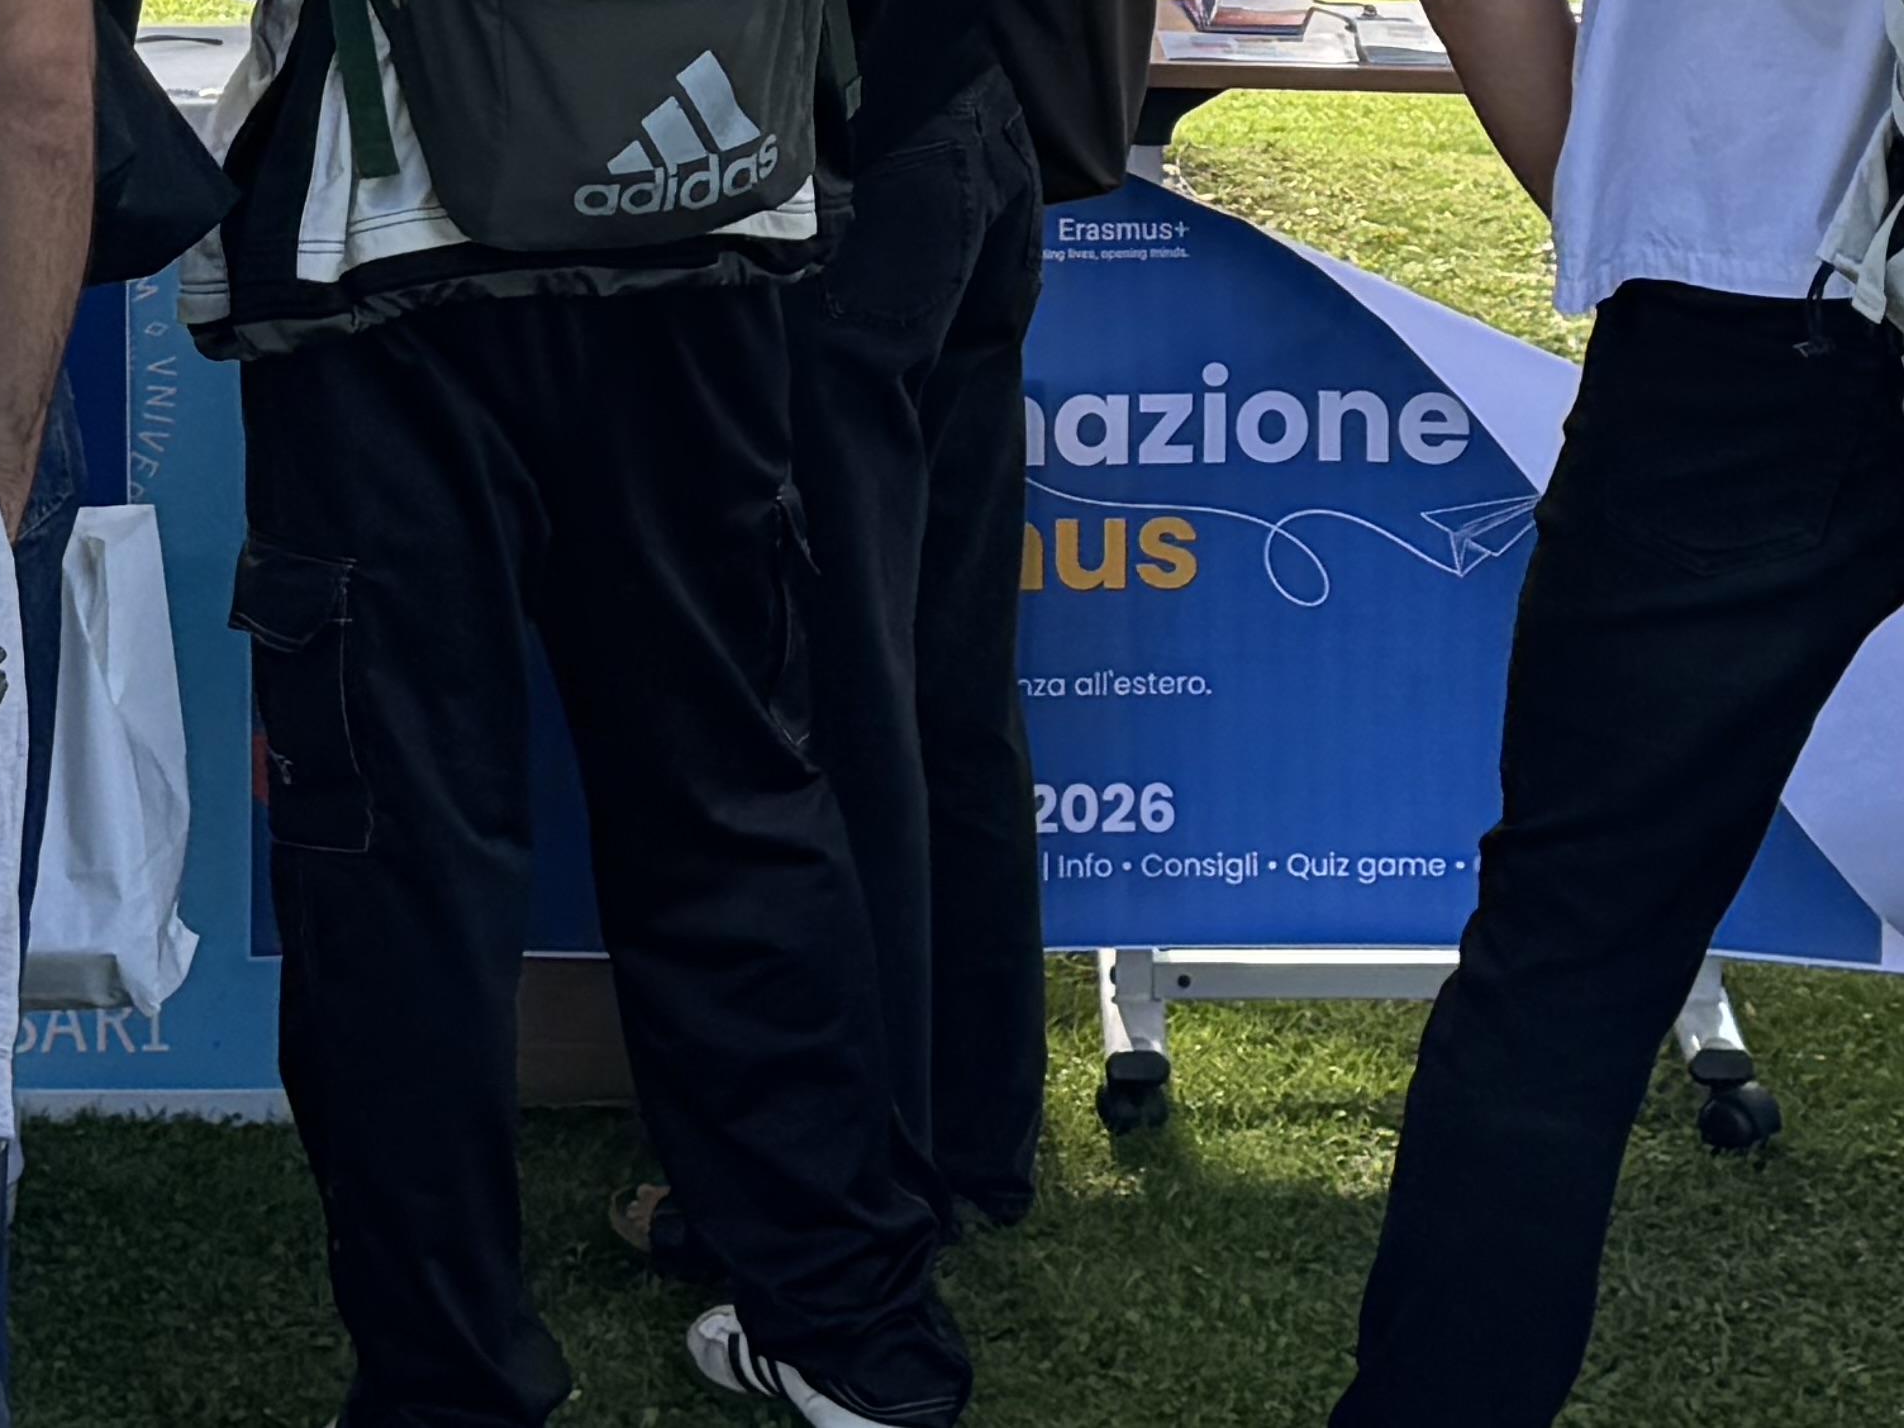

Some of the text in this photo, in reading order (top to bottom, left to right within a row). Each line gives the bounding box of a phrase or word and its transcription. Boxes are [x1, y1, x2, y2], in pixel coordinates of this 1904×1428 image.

[574, 134, 778, 215] adidas
[1059, 218, 1190, 241] Erasmus+
[1075, 669, 1213, 696] all'estero.
[1035, 782, 1176, 833] 2026
[1058, 851, 1446, 884] Info Consigli Quiz game
